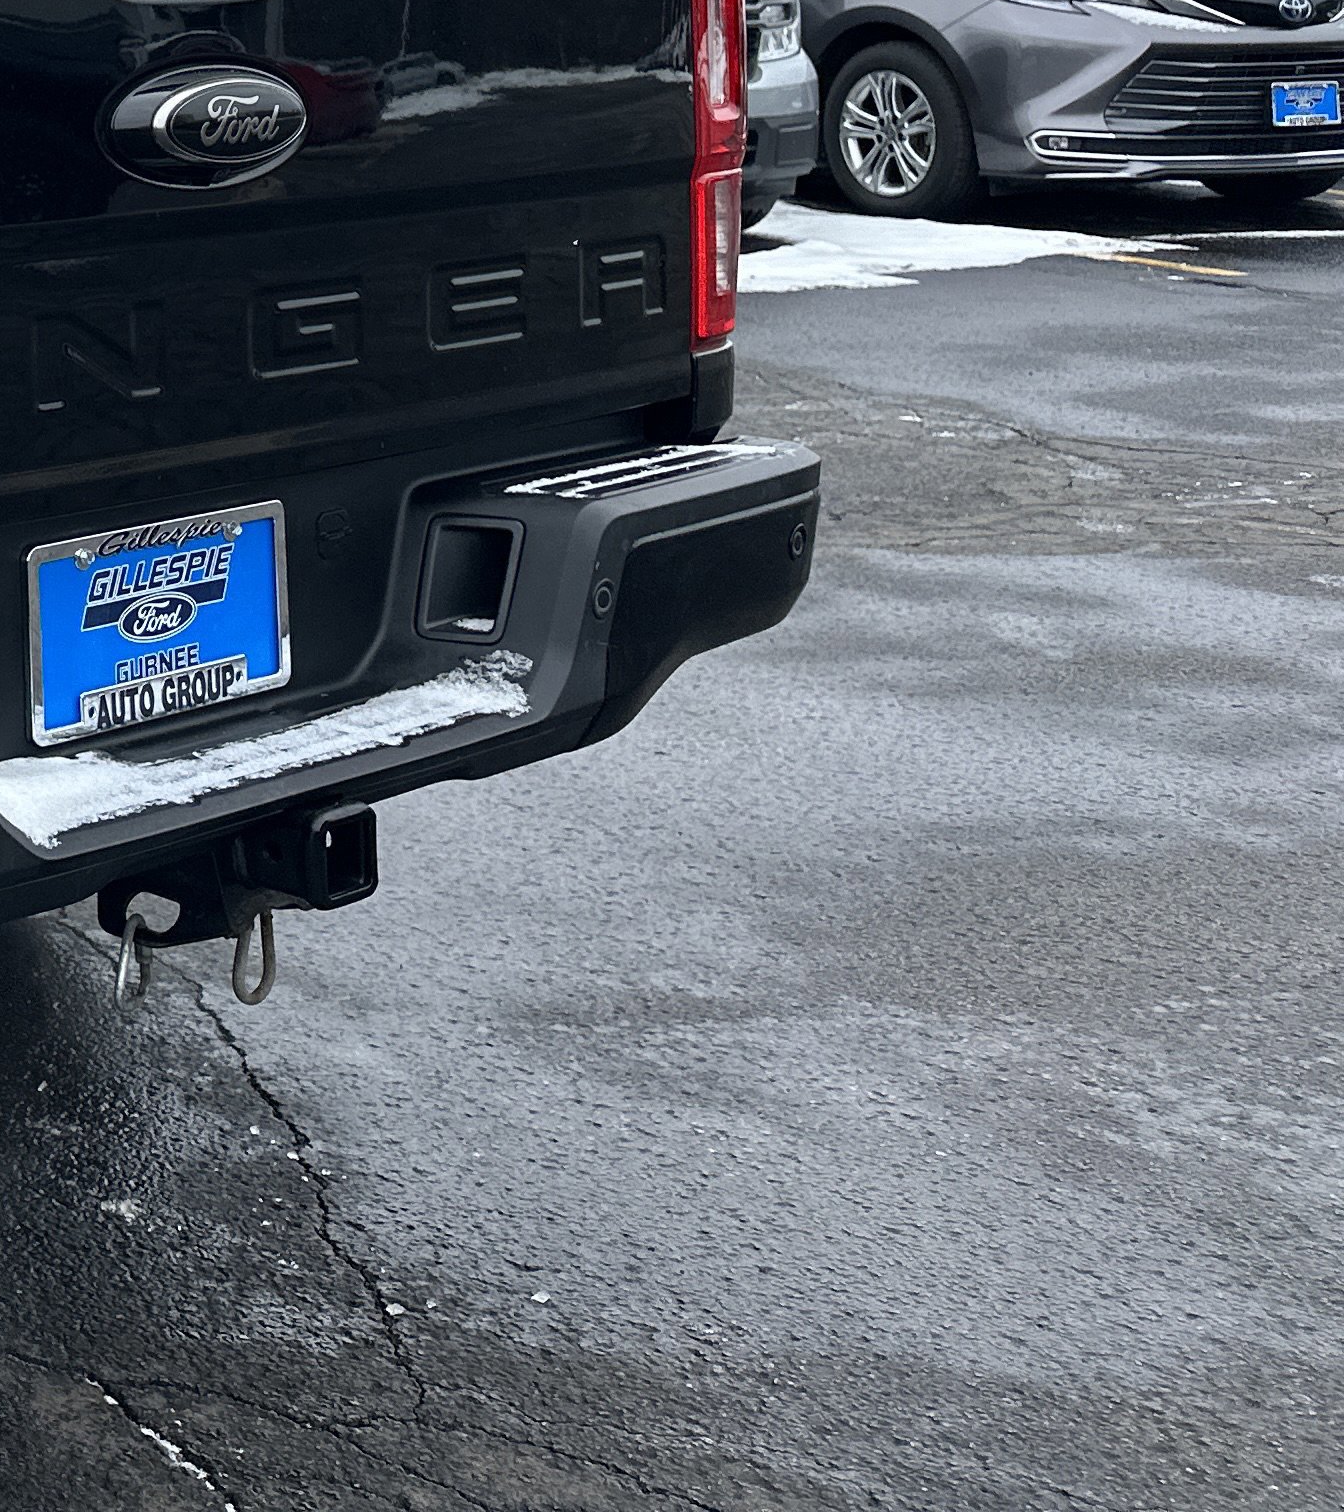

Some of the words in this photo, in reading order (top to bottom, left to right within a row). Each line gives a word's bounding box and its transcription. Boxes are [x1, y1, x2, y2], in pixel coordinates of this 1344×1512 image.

[200, 95, 280, 147] Ford
[98, 519, 223, 557] Gillespie
[88, 543, 235, 604] GILLESPIE
[132, 601, 182, 636] Ford
[115, 643, 200, 684] GURNEE
[96, 687, 155, 729] AUTO
[161, 663, 236, 714] GROUP
